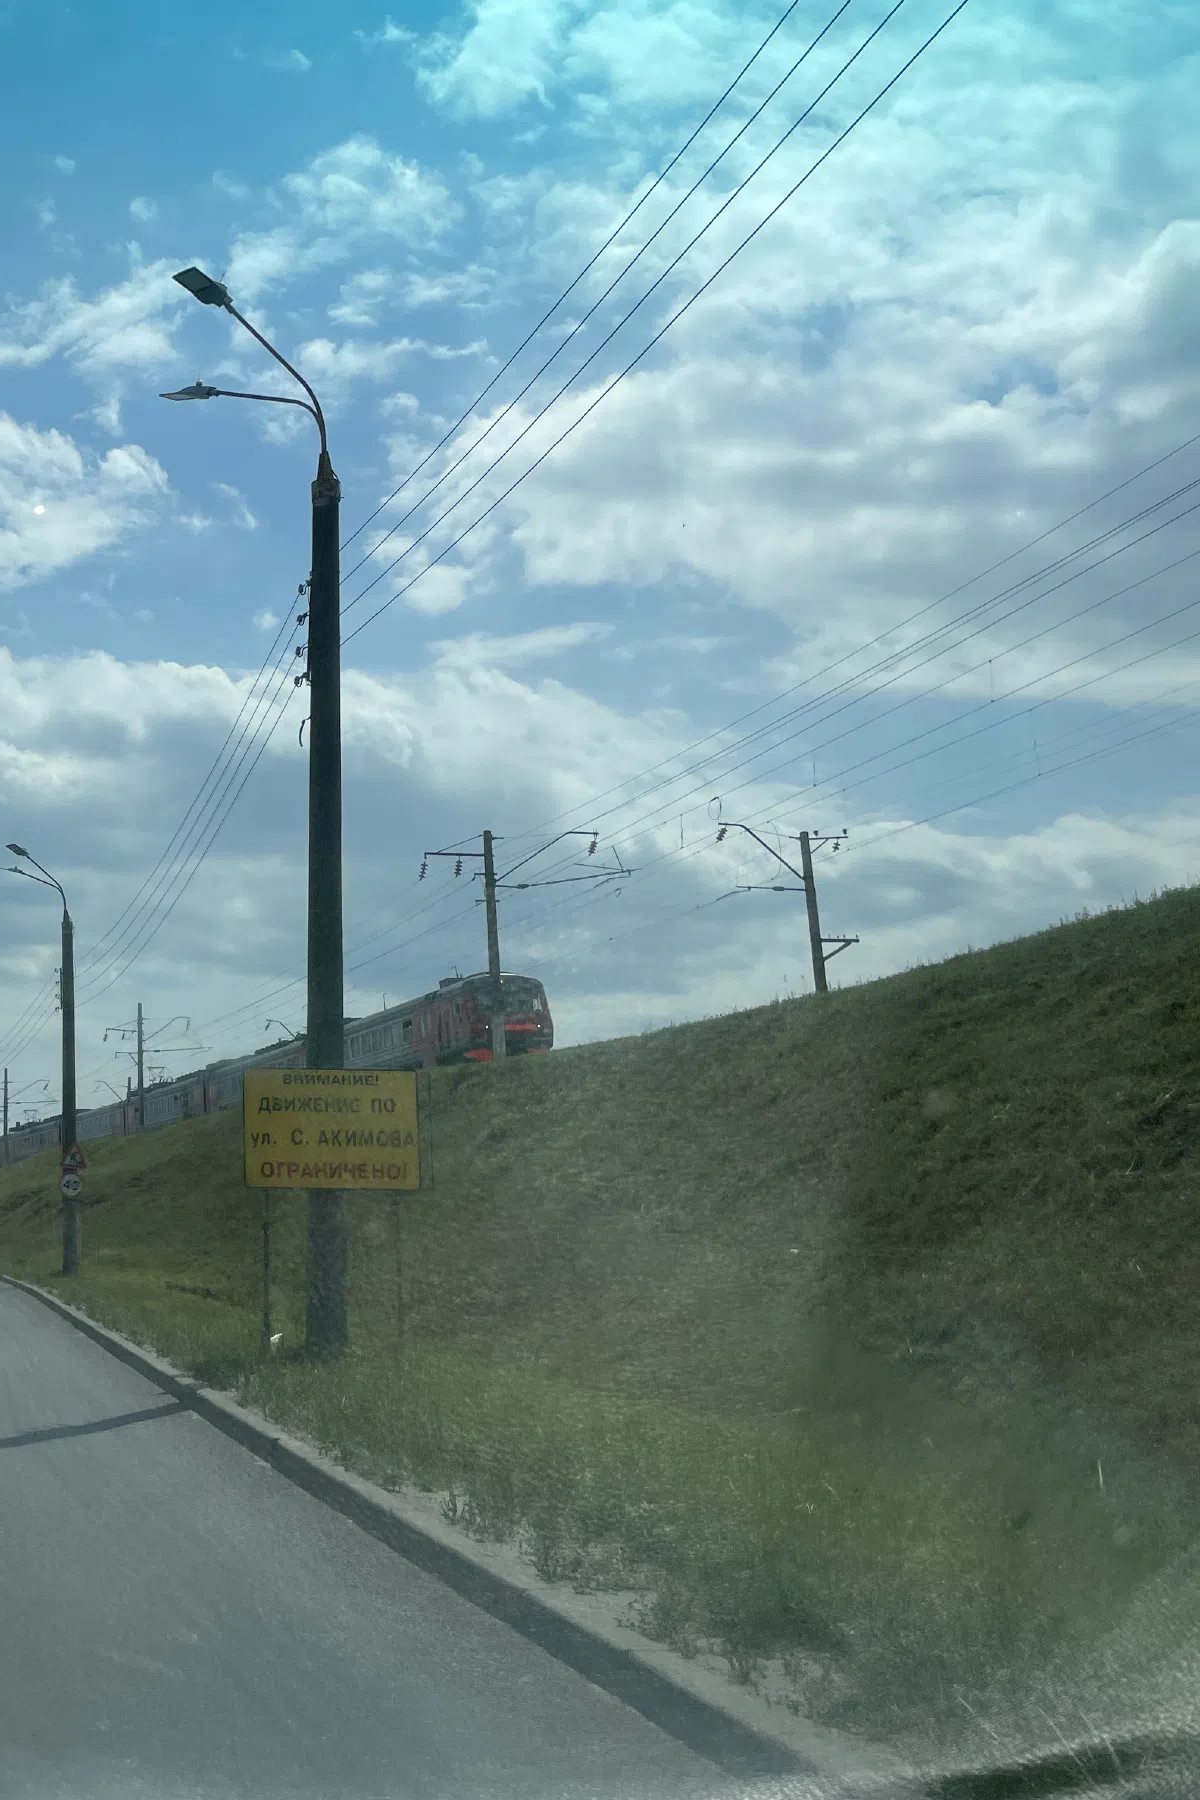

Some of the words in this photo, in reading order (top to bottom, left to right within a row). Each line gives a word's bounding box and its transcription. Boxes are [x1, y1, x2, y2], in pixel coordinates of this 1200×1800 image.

[282, 1074, 380, 1086] ВНИМАНИЕ!
[258, 1096, 361, 1114] ДВИЖЕНИЕ
[371, 1098, 397, 1113] ПО
[251, 1131, 278, 1149] ул.
[290, 1128, 310, 1146] С.
[317, 1129, 416, 1148] АКИМОВА
[260, 1161, 408, 1181] ОГРАНИЧЕНО!
[63, 1180, 78, 1190] 40
